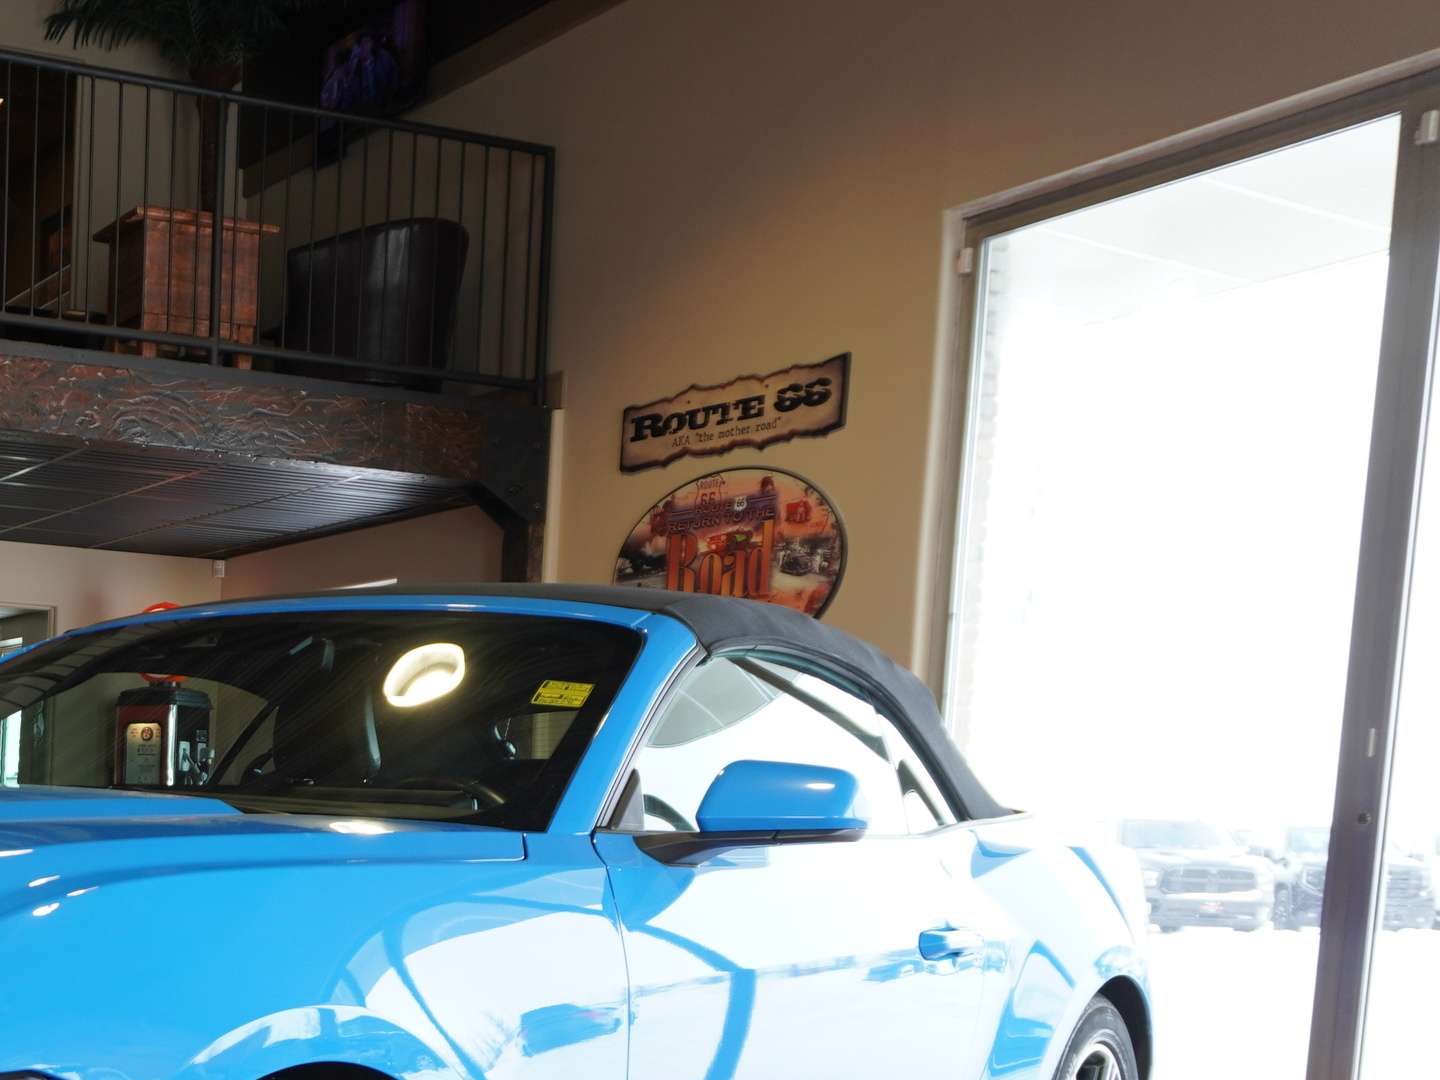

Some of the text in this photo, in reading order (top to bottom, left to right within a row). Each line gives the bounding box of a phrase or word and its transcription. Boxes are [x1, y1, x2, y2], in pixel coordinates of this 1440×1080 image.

[630, 377, 833, 443] ROUTE 66
[671, 435, 691, 448] AKA
[718, 425, 751, 440] mother
[669, 515, 721, 531] RETURN
[667, 519, 775, 597] Road
